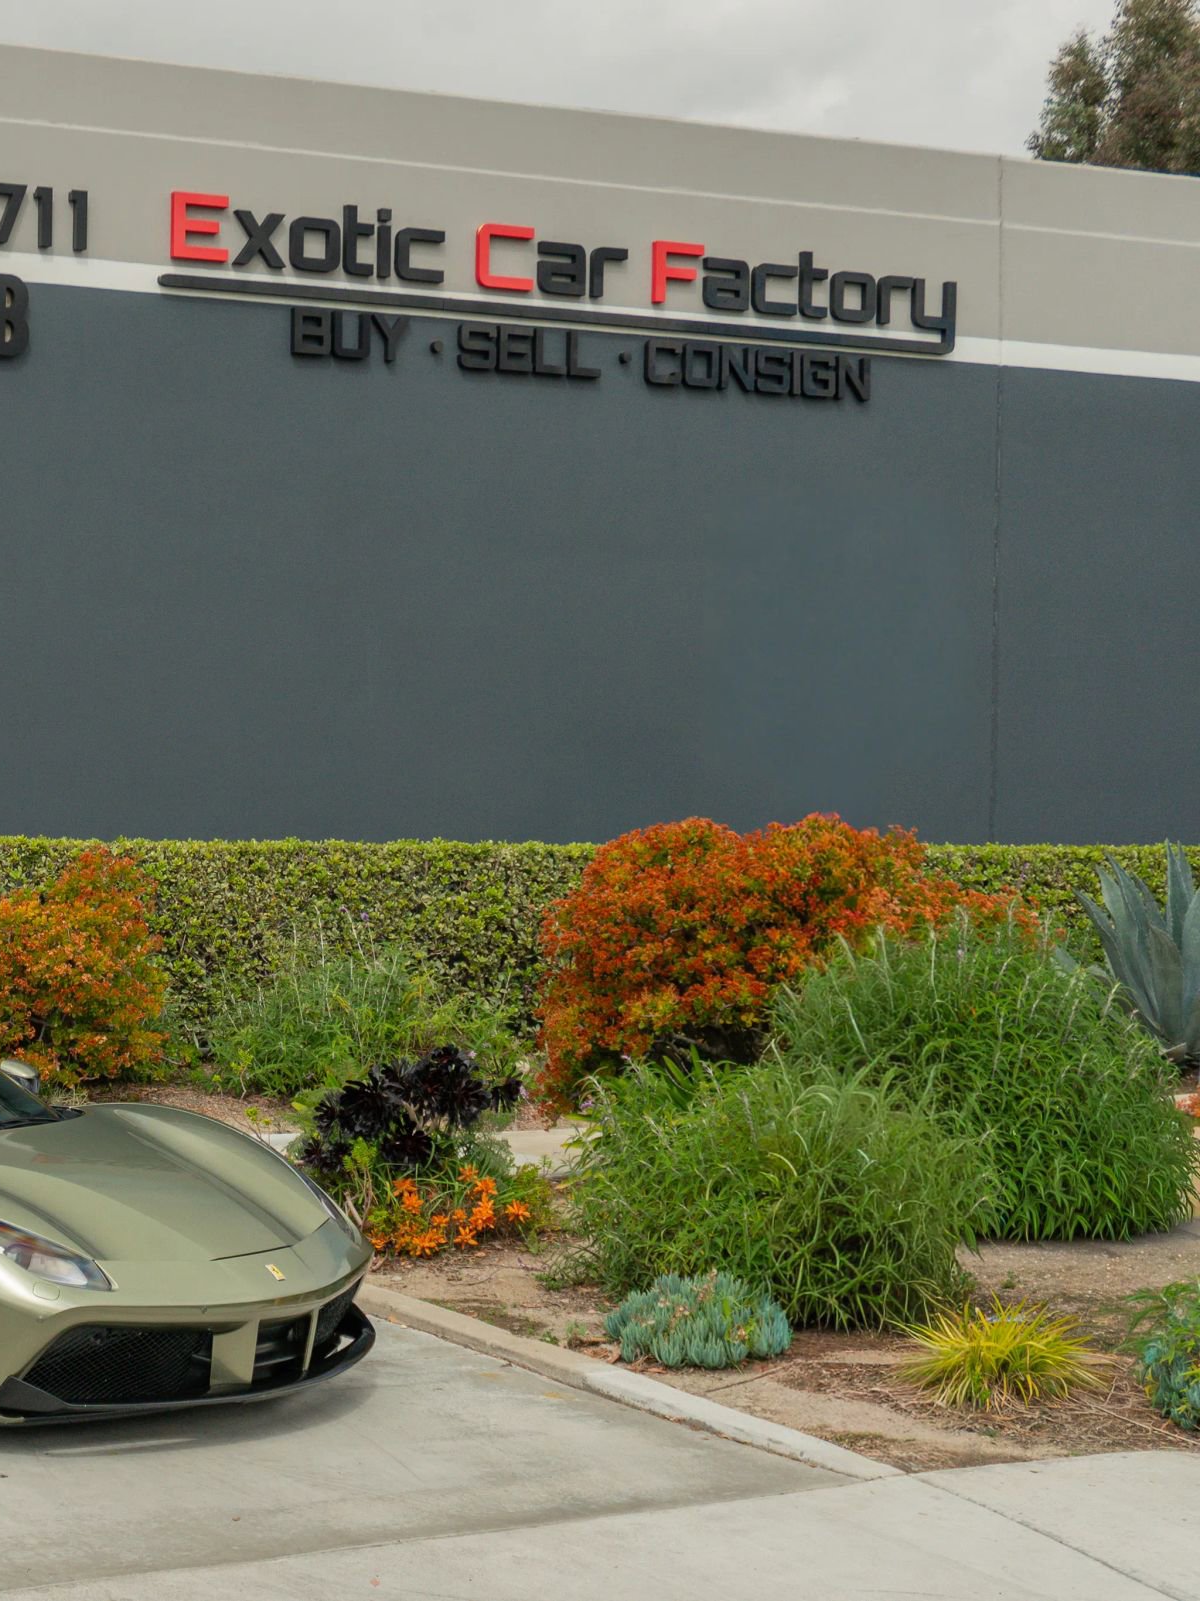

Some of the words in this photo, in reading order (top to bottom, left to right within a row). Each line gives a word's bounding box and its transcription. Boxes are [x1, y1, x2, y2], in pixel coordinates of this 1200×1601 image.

[170, 190, 446, 283] Exotic
[476, 223, 628, 298] Car
[651, 240, 957, 353] Factory
[290, 307, 406, 363] BUY
[457, 323, 601, 378] SELL
[644, 339, 872, 401] CONSIGN
